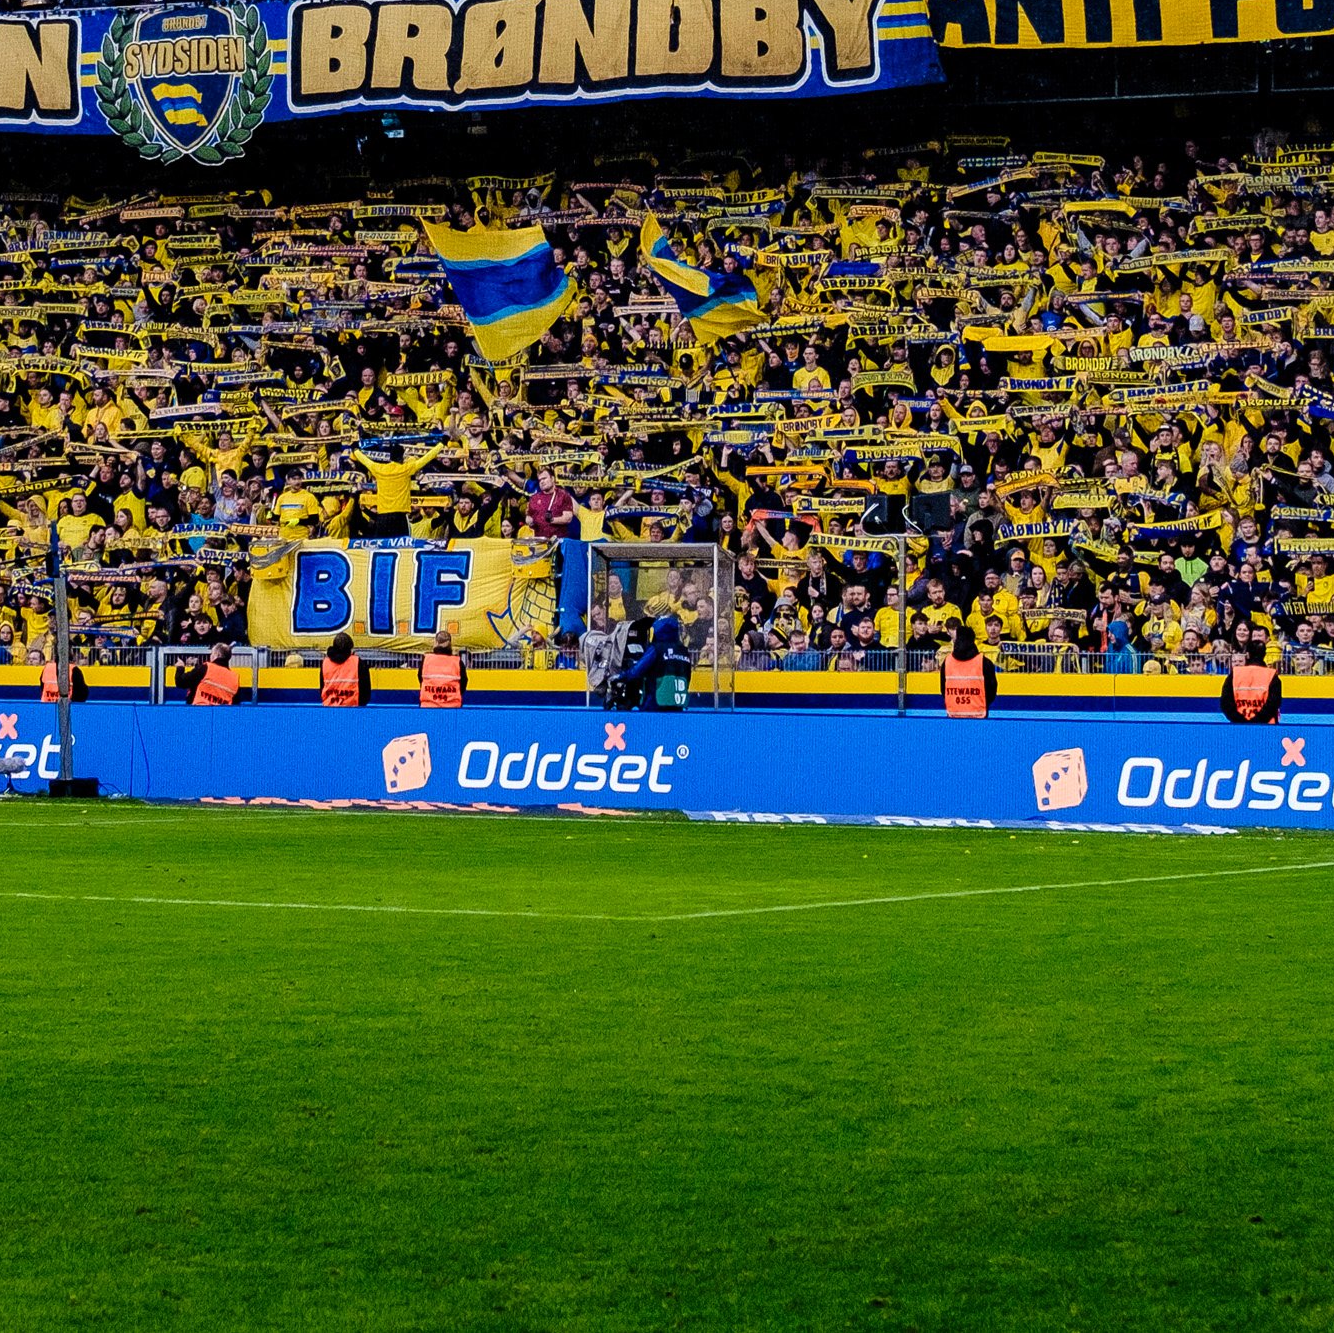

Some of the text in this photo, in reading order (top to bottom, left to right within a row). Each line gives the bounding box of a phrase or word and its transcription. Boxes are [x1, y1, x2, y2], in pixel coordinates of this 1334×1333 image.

[124, 36, 245, 78] SYDSIDEN
[1010, 378, 1064, 389] BRØNDBY
[947, 687, 980, 696] STEWARD
[457, 741, 673, 793] Oddset
